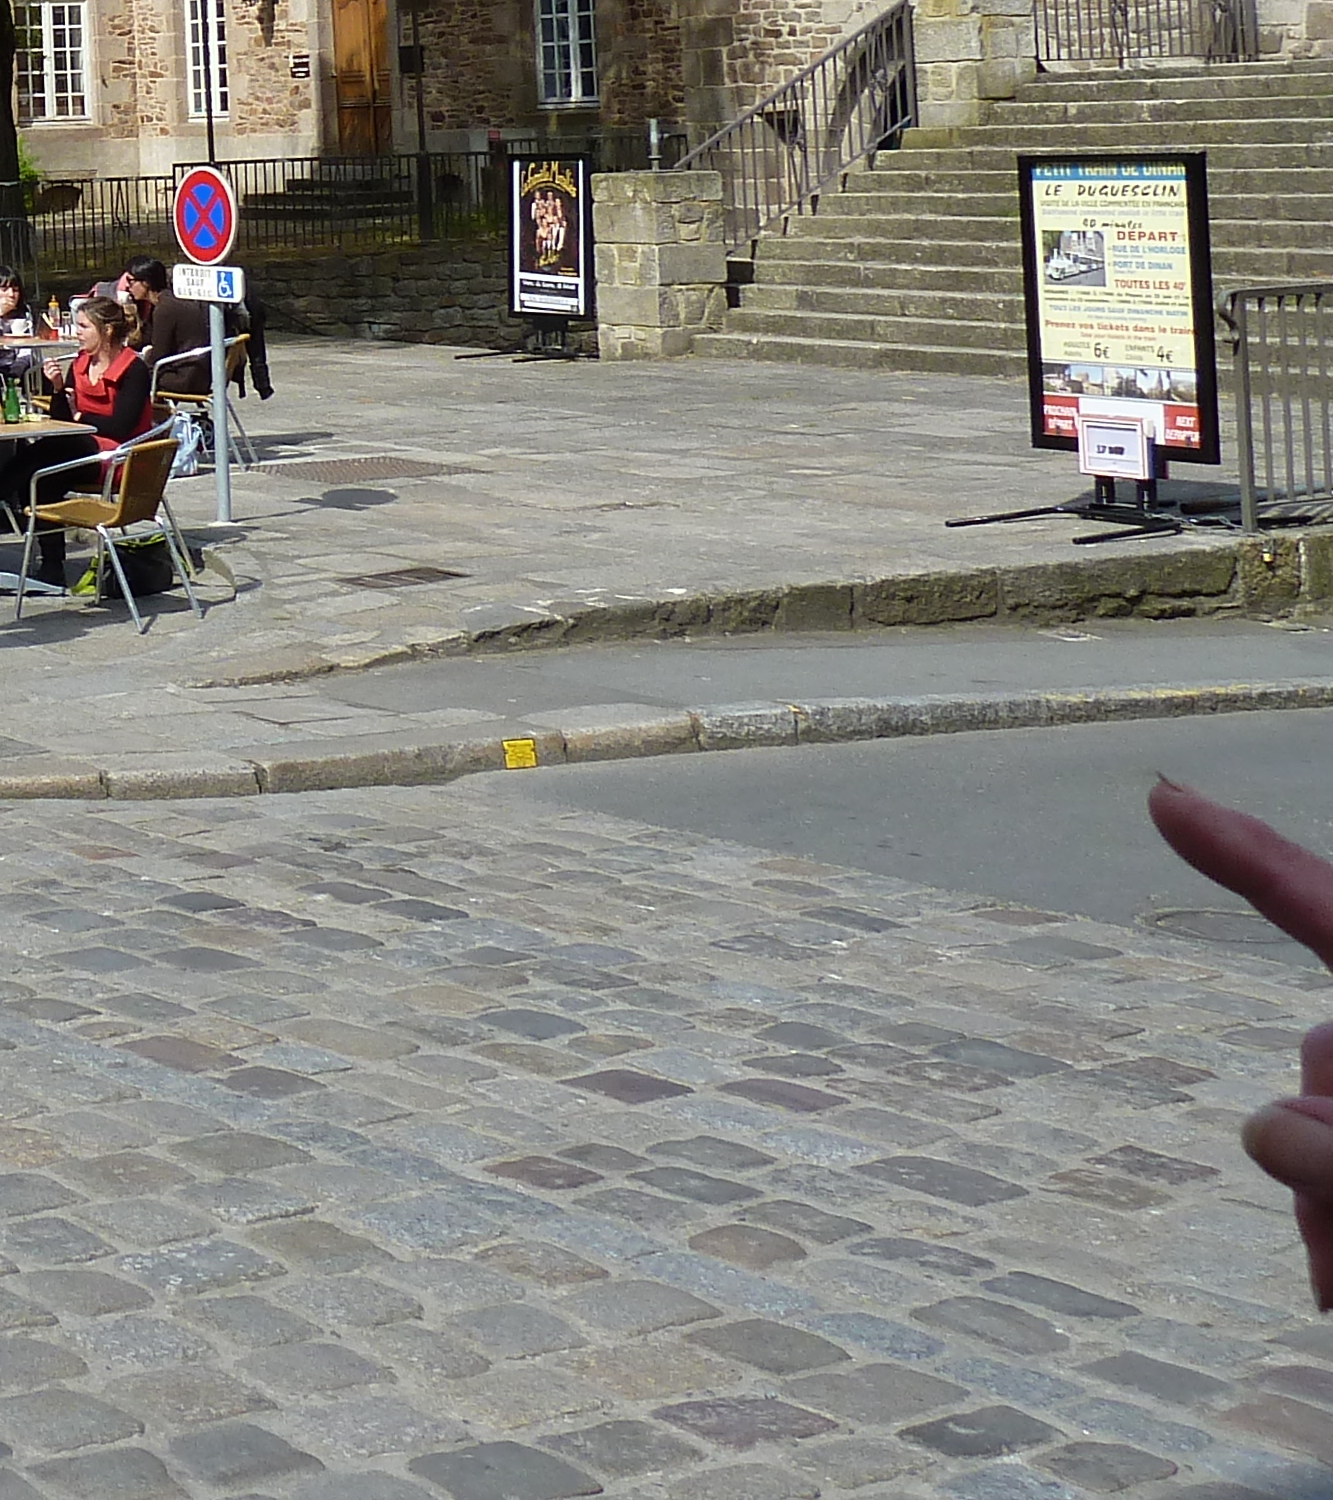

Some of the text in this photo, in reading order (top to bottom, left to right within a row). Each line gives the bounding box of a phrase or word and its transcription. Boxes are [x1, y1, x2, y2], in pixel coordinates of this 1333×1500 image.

[1045, 184, 1178, 197] LE DUGUESCLIN
[179, 268, 211, 278] INTERDIT
[1114, 279, 1150, 290] TOUTES
[1153, 280, 1170, 291] LES
